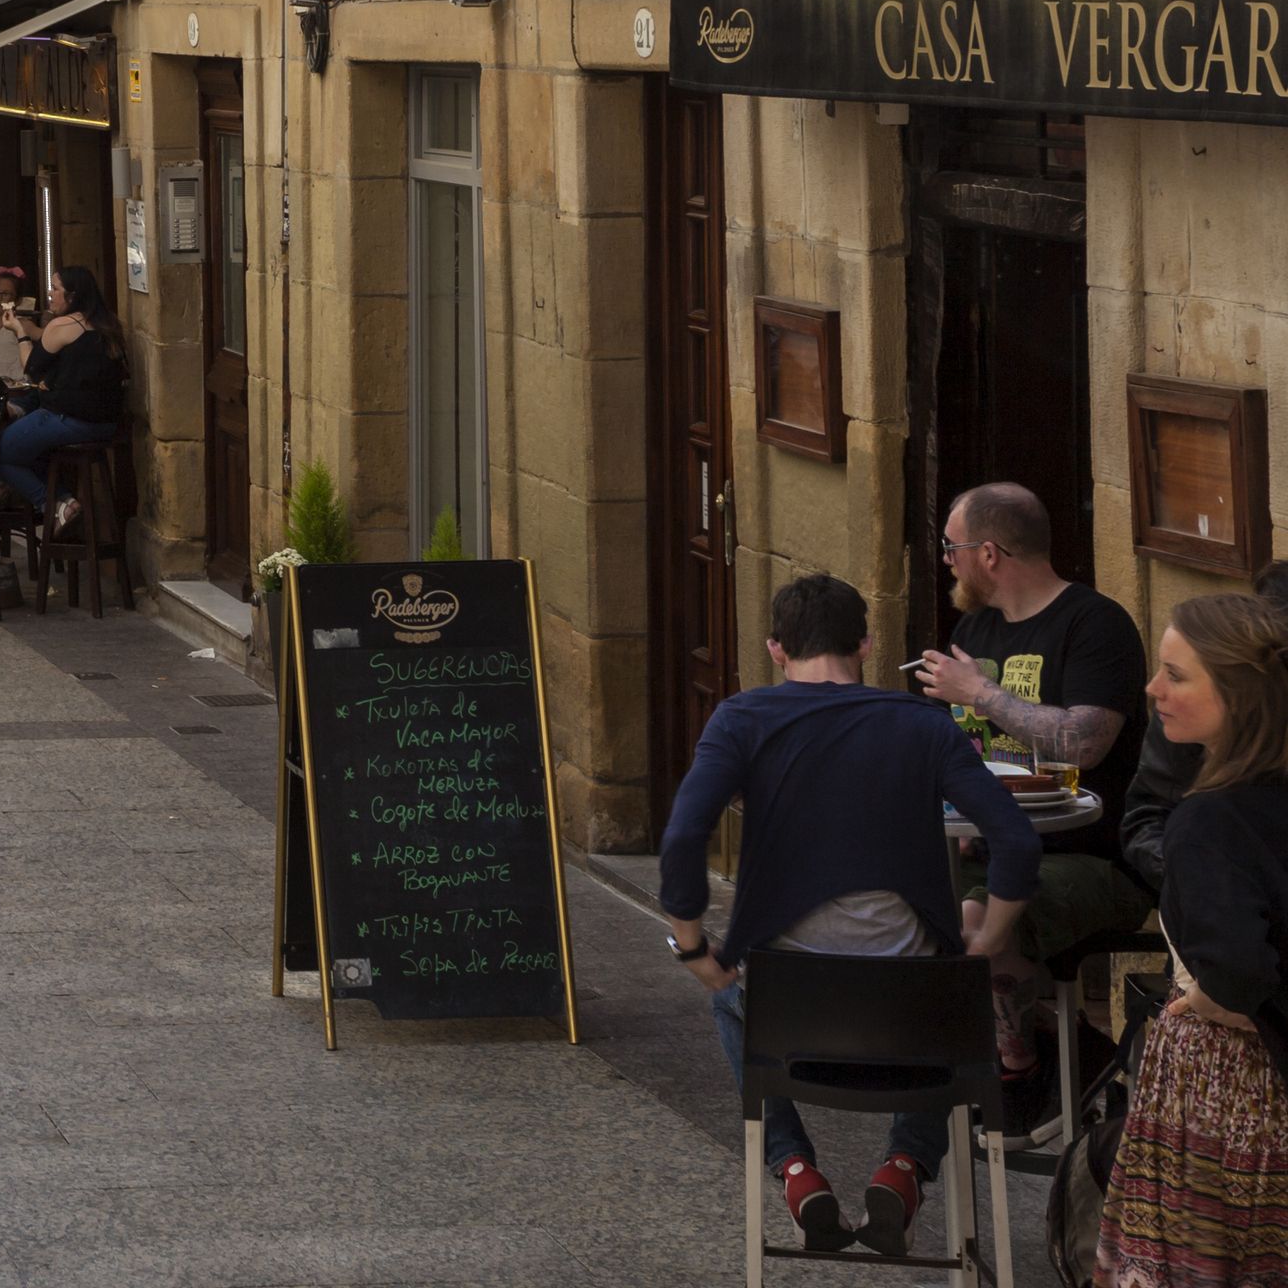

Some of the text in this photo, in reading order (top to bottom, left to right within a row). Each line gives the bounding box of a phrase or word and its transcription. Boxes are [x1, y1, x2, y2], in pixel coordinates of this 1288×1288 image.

[635, 17, 652, 49] 21
[697, 6, 753, 57] Radeberger
[874, 0, 995, 84] CASA
[371, 589, 458, 627] Radeberger
[370, 651, 532, 684] SUGERENCIAS
[1018, 672, 1033, 683] THE
[1025, 661, 1040, 671] OUT
[1005, 683, 1036, 698] UMAN!
[396, 720, 520, 749] VACA MAYOR
[366, 754, 458, 778] KOKOTXAS
[372, 841, 440, 869] ARROZ
